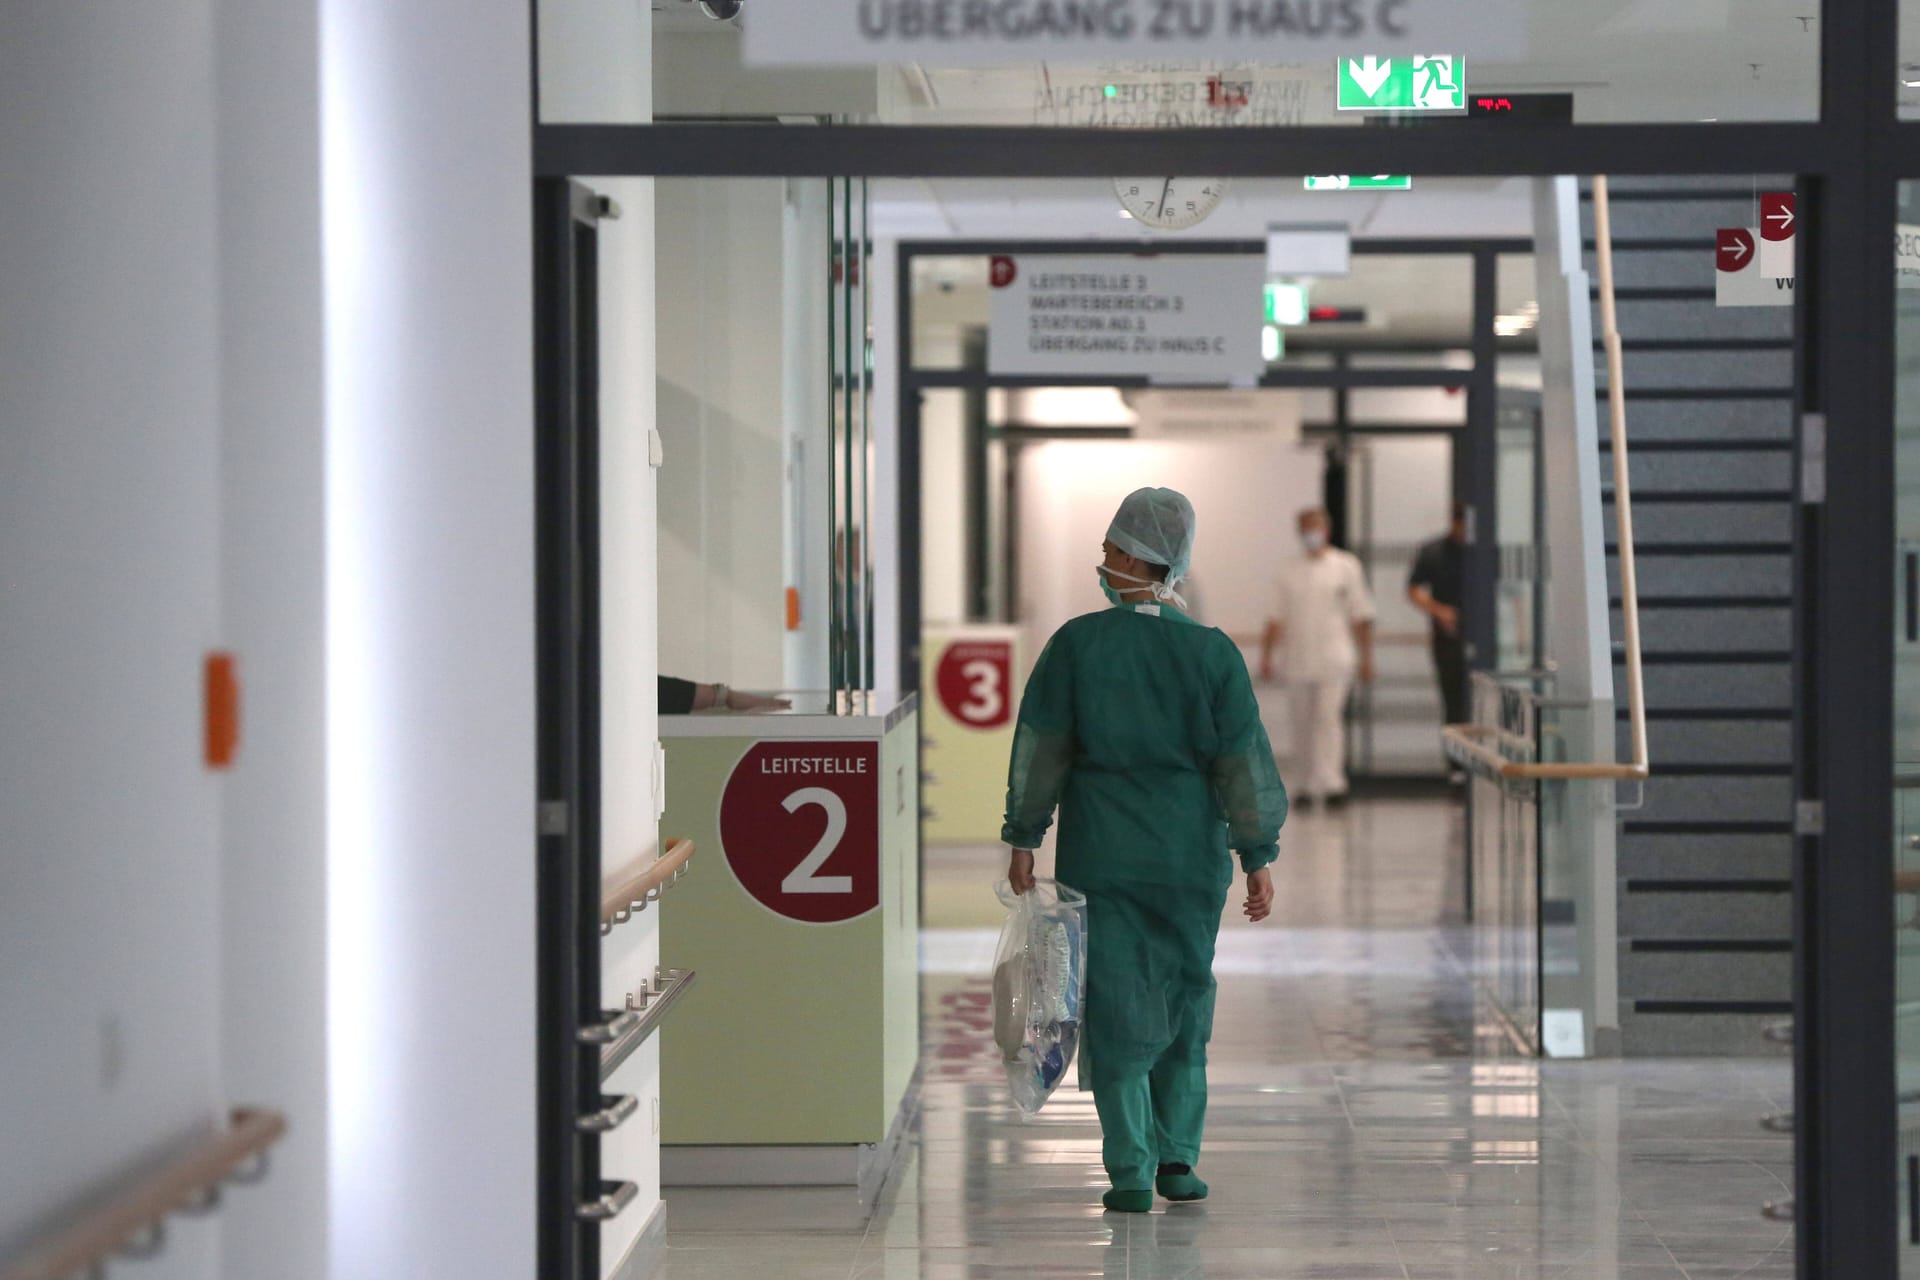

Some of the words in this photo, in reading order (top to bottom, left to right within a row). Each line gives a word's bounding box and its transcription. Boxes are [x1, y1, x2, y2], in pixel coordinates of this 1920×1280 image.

[1148, 0, 1213, 40] ZU
[1226, 0, 1364, 38] HAUS
[1373, 0, 1411, 38] C
[1164, 208, 1175, 217] 6
[1029, 273, 1130, 290] LEITSTELLE
[1029, 314, 1105, 332] STATION
[960, 660, 1003, 721] 3
[761, 757, 867, 774] LEITSTELLE
[780, 786, 853, 894] 2
